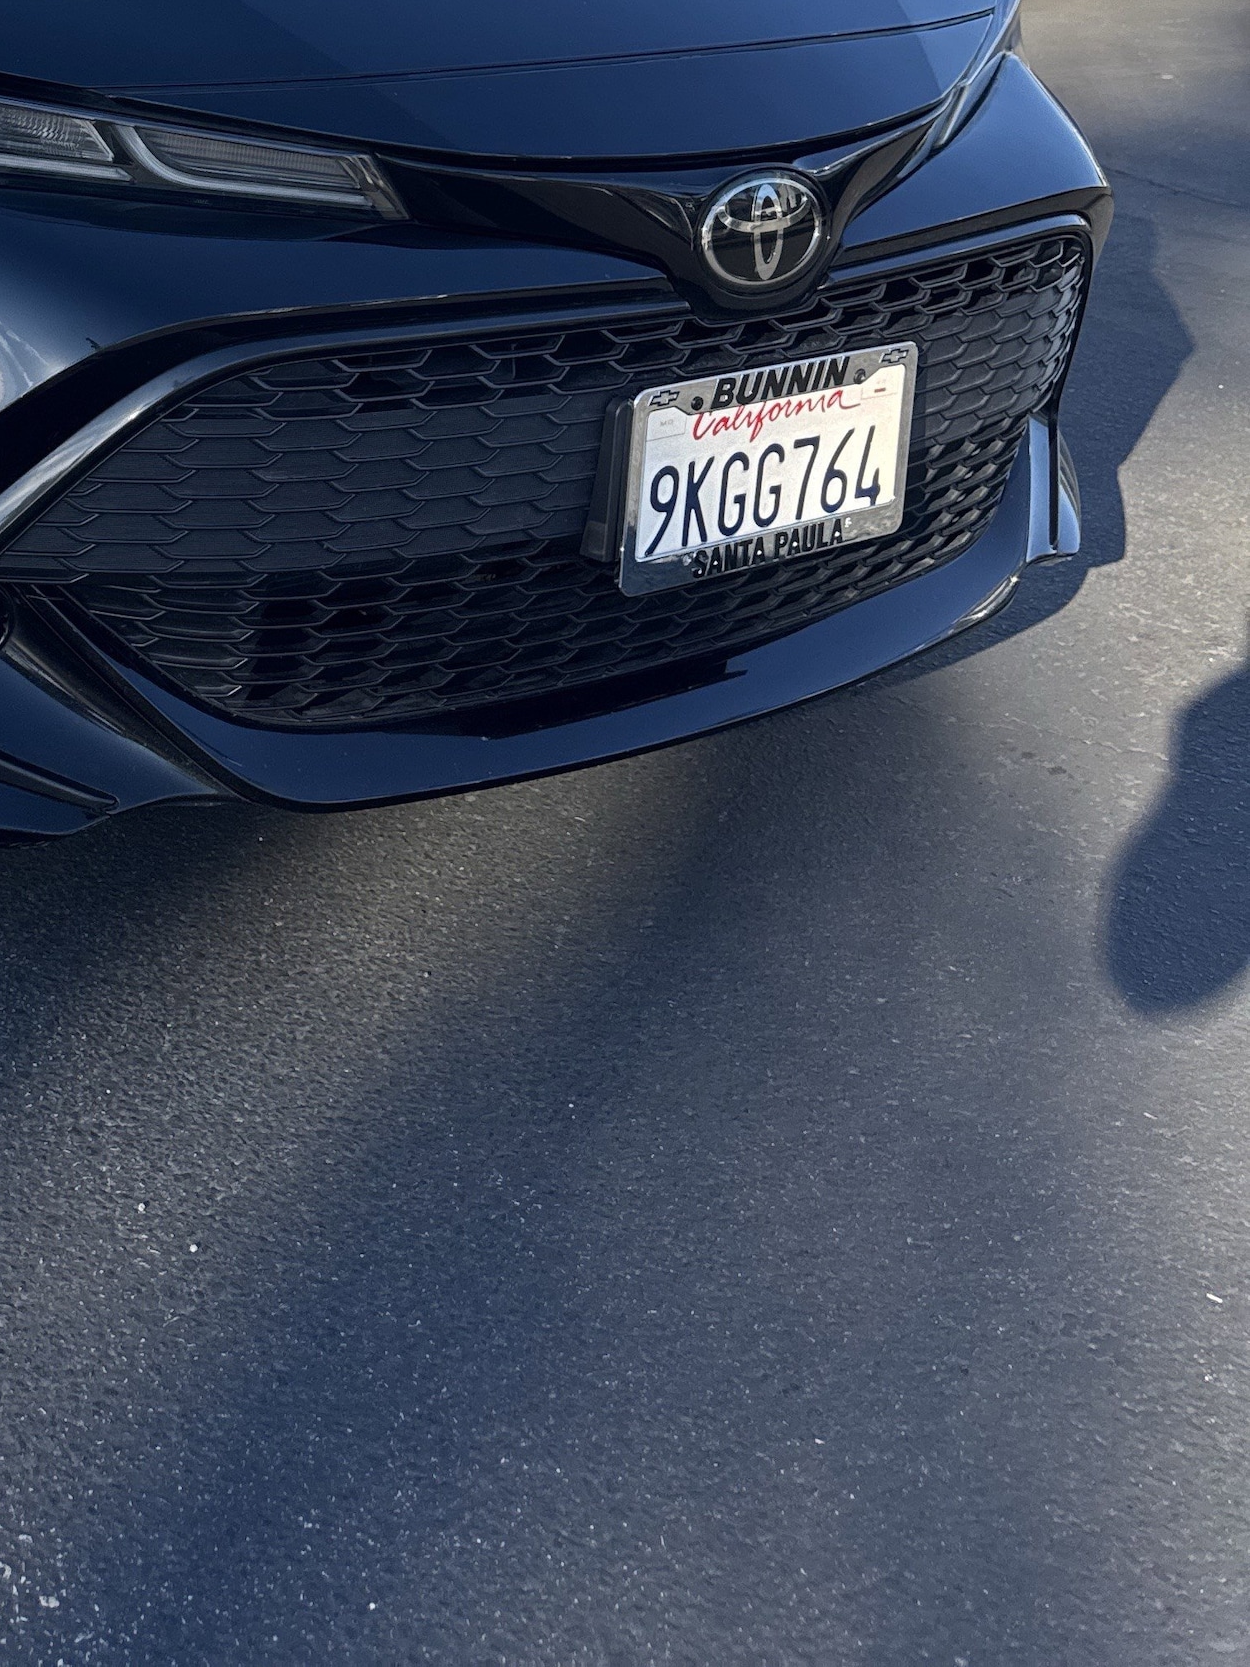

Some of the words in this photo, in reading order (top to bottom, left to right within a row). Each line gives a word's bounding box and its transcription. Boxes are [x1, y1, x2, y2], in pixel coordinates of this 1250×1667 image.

[709, 355, 850, 410] BUNNIN
[692, 388, 861, 442] California
[645, 424, 881, 557] 9KGG764
[691, 535, 766, 579] SANTA
[773, 518, 844, 559] PAULA
